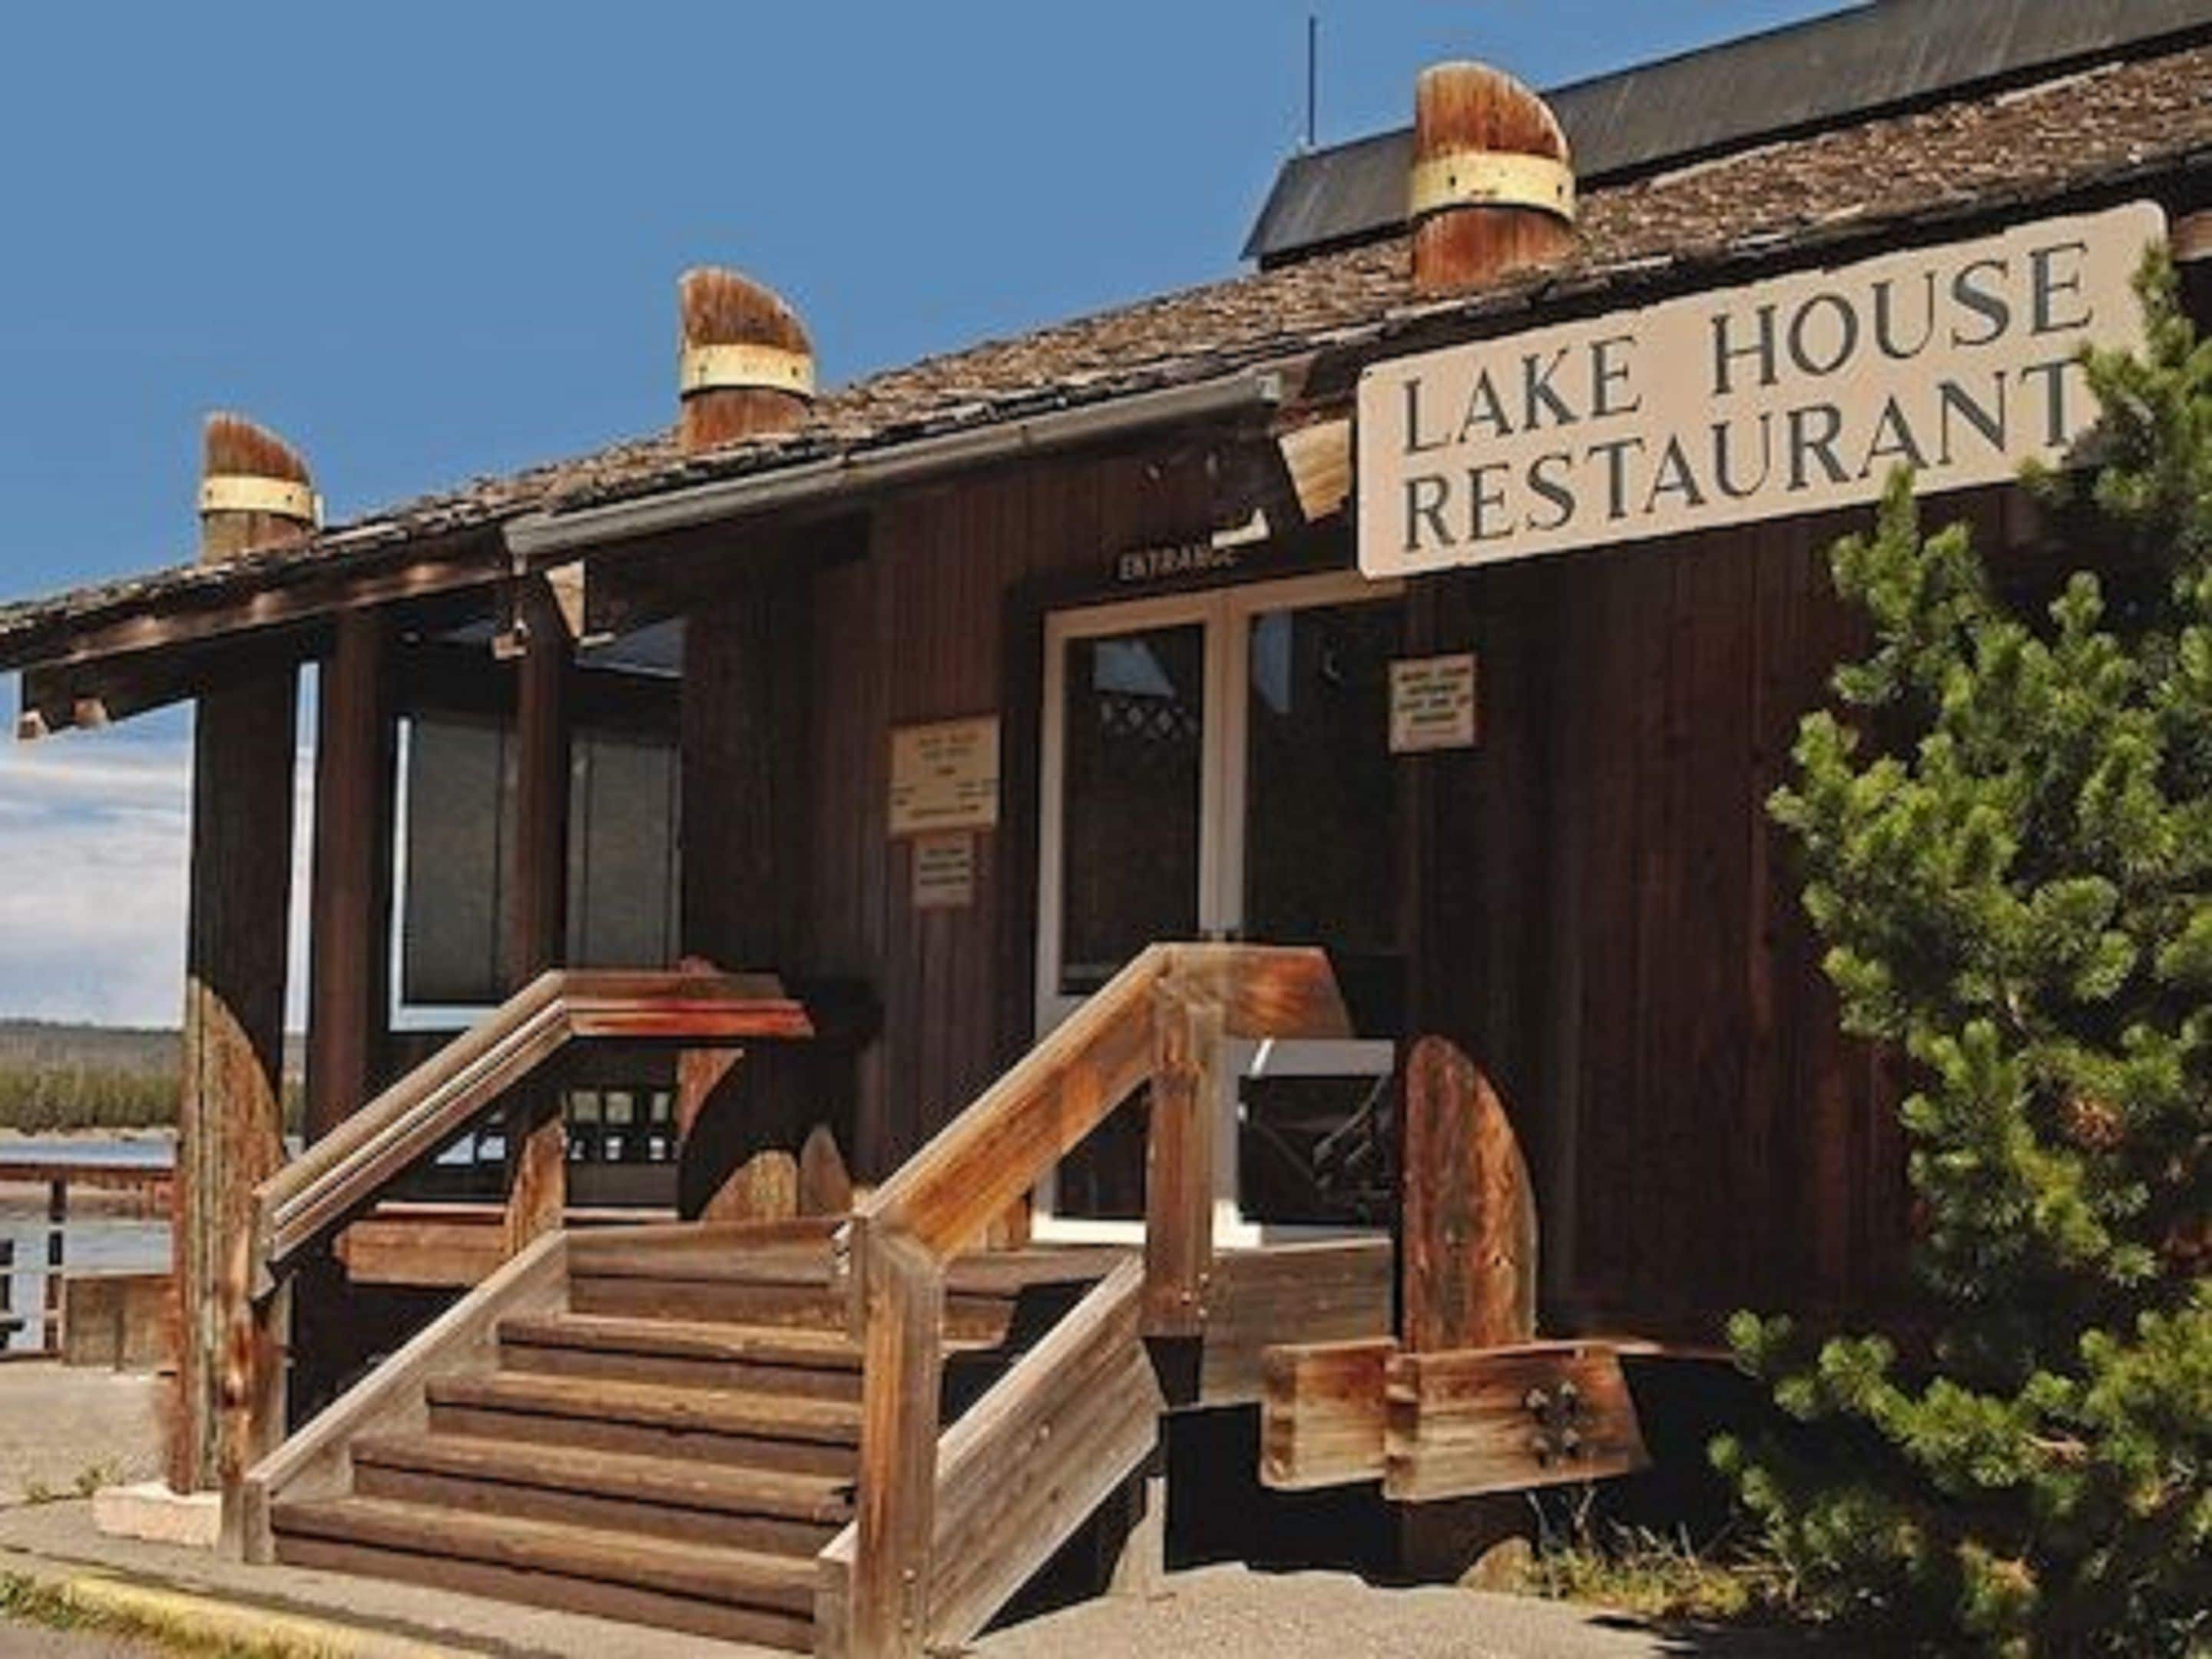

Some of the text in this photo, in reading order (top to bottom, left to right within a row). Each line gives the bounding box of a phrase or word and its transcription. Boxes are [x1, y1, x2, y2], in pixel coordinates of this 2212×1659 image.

[1404, 241, 2094, 456] LAKE HOUSE
[1404, 356, 2086, 555] RESTAURANT
